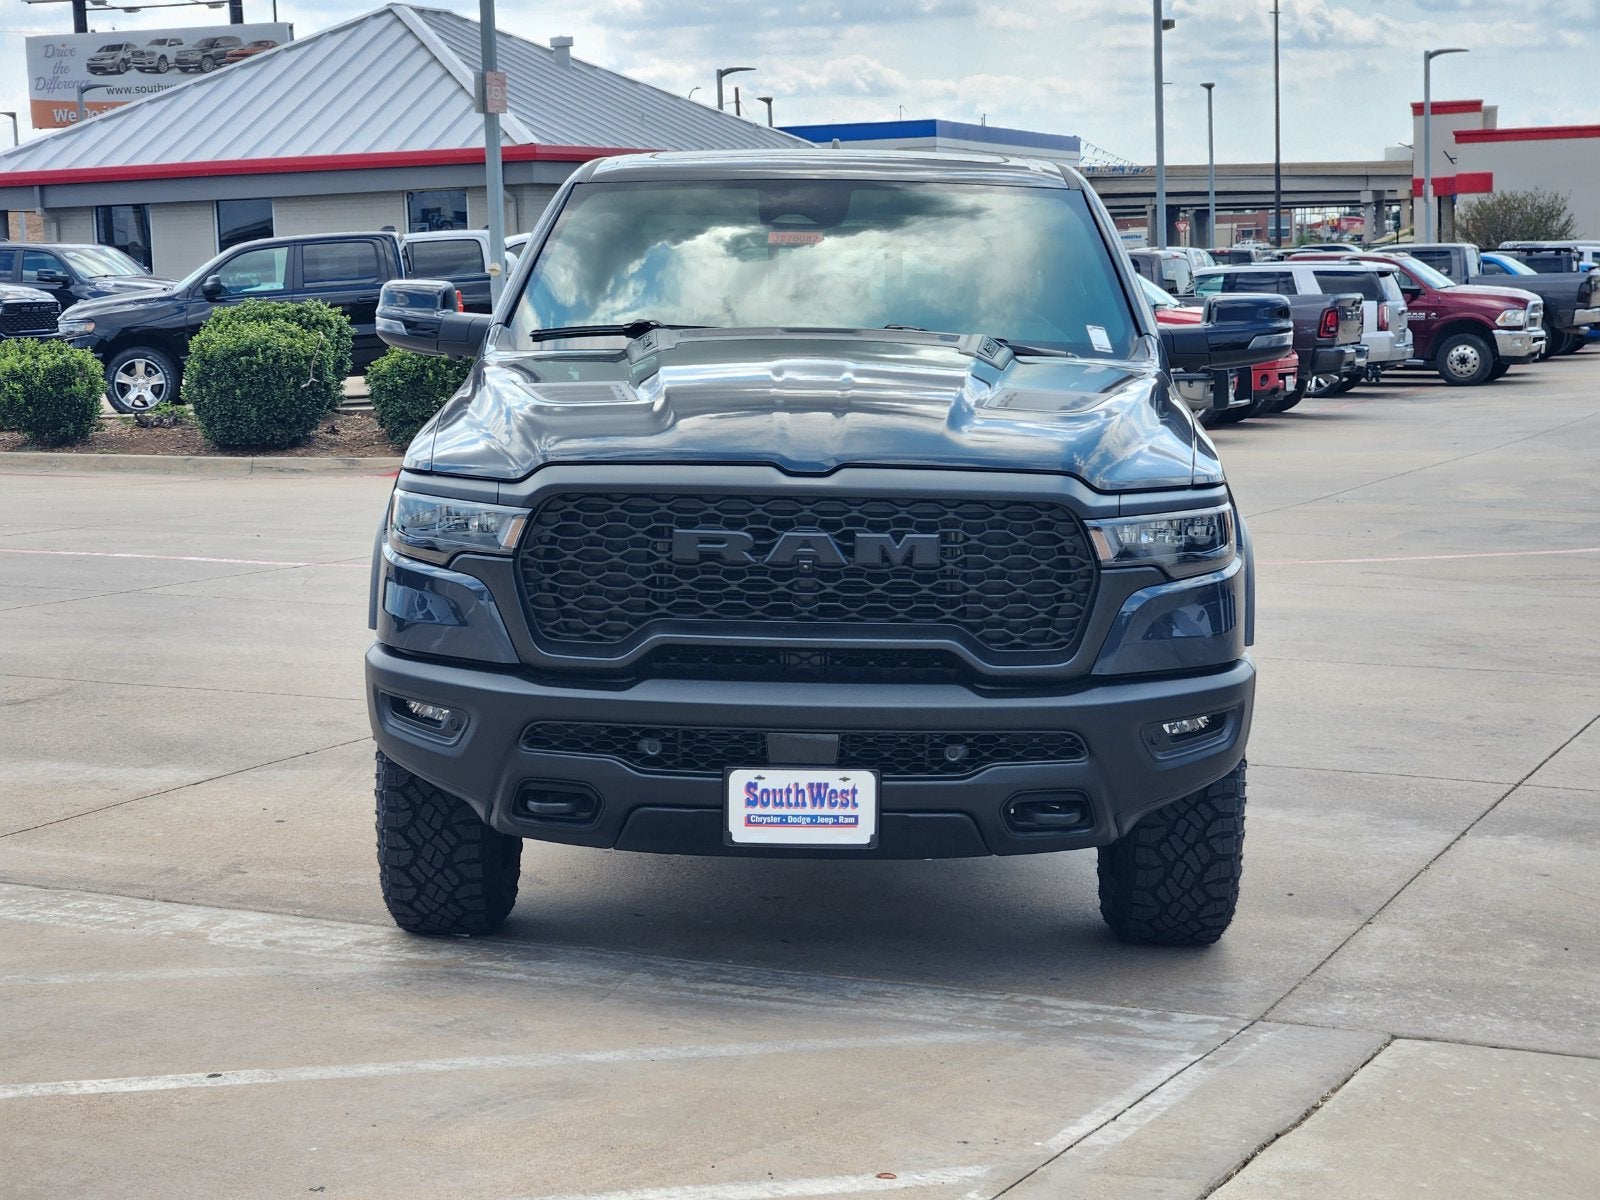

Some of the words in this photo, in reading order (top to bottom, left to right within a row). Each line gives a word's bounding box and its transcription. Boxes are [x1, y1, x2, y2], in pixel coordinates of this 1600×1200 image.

[43, 43, 77, 59] Drive
[52, 59, 71, 75] the
[53, 108, 77, 122] We
[672, 528, 941, 565] RAM
[750, 815, 781, 824] Chrysler
[787, 815, 811, 824] Dodge
[816, 816, 834, 825] Jeep
[838, 816, 855, 824] Ram
